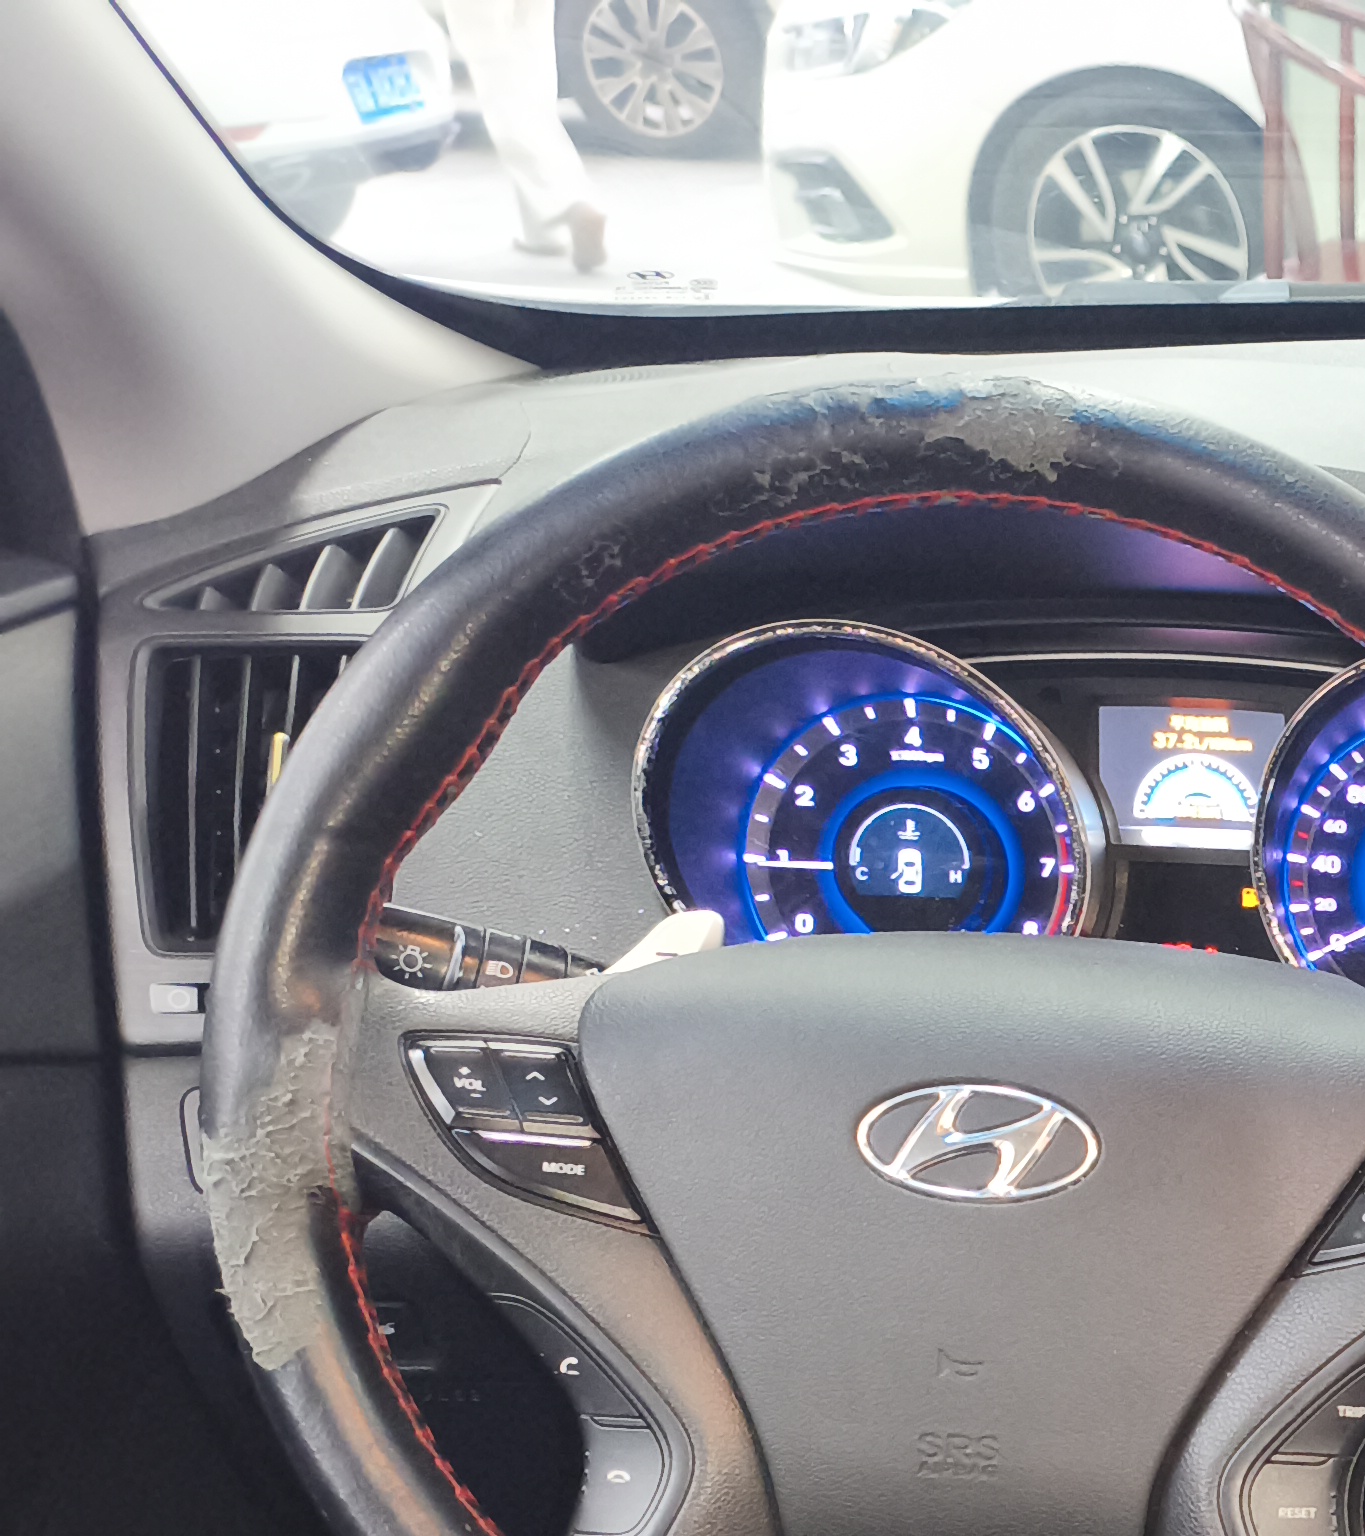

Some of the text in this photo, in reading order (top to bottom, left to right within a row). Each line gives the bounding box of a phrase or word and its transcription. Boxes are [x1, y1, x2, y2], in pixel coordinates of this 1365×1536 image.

[904, 726, 922, 747] 4
[839, 744, 857, 767] 3
[972, 747, 990, 769] 5
[794, 785, 815, 806] 2
[1017, 790, 1036, 812] 6
[1323, 819, 1347, 834] 60
[1039, 857, 1056, 877] 7
[1311, 854, 1341, 873] 40
[855, 866, 869, 881] C
[949, 869, 962, 884] H
[1314, 897, 1337, 912] 20
[794, 912, 814, 934] 0
[453, 1076, 486, 1091] VOL
[542, 1161, 586, 1176] MODE
[917, 1432, 999, 1460] SRS
[1278, 1507, 1317, 1519] RESET
